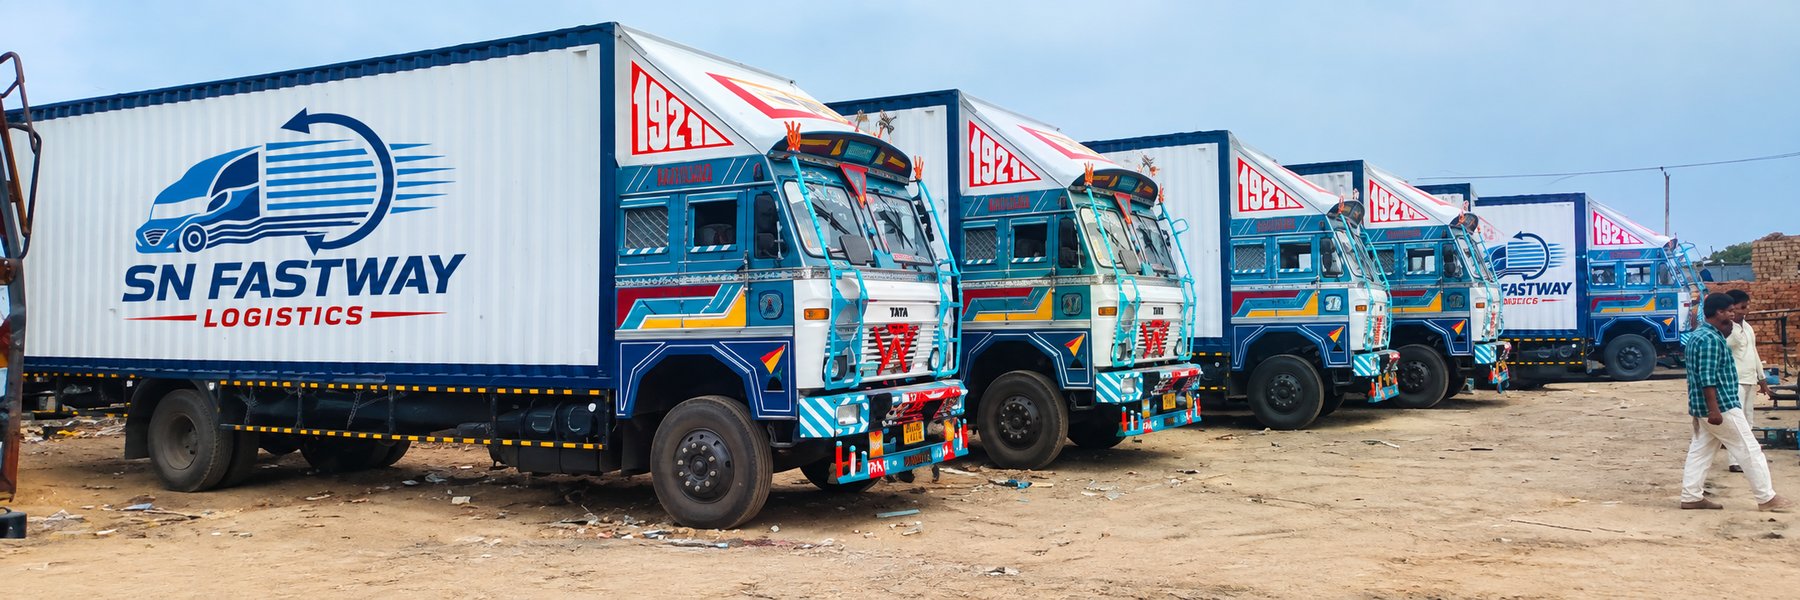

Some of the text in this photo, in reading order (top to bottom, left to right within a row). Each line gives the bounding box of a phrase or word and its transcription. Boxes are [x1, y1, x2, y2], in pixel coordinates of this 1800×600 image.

[122, 253, 466, 302] SN FASTWAY
[1500, 281, 1572, 297] FASTWAY
[203, 305, 363, 328] LOGISTICS
[889, 307, 909, 318] TATA
